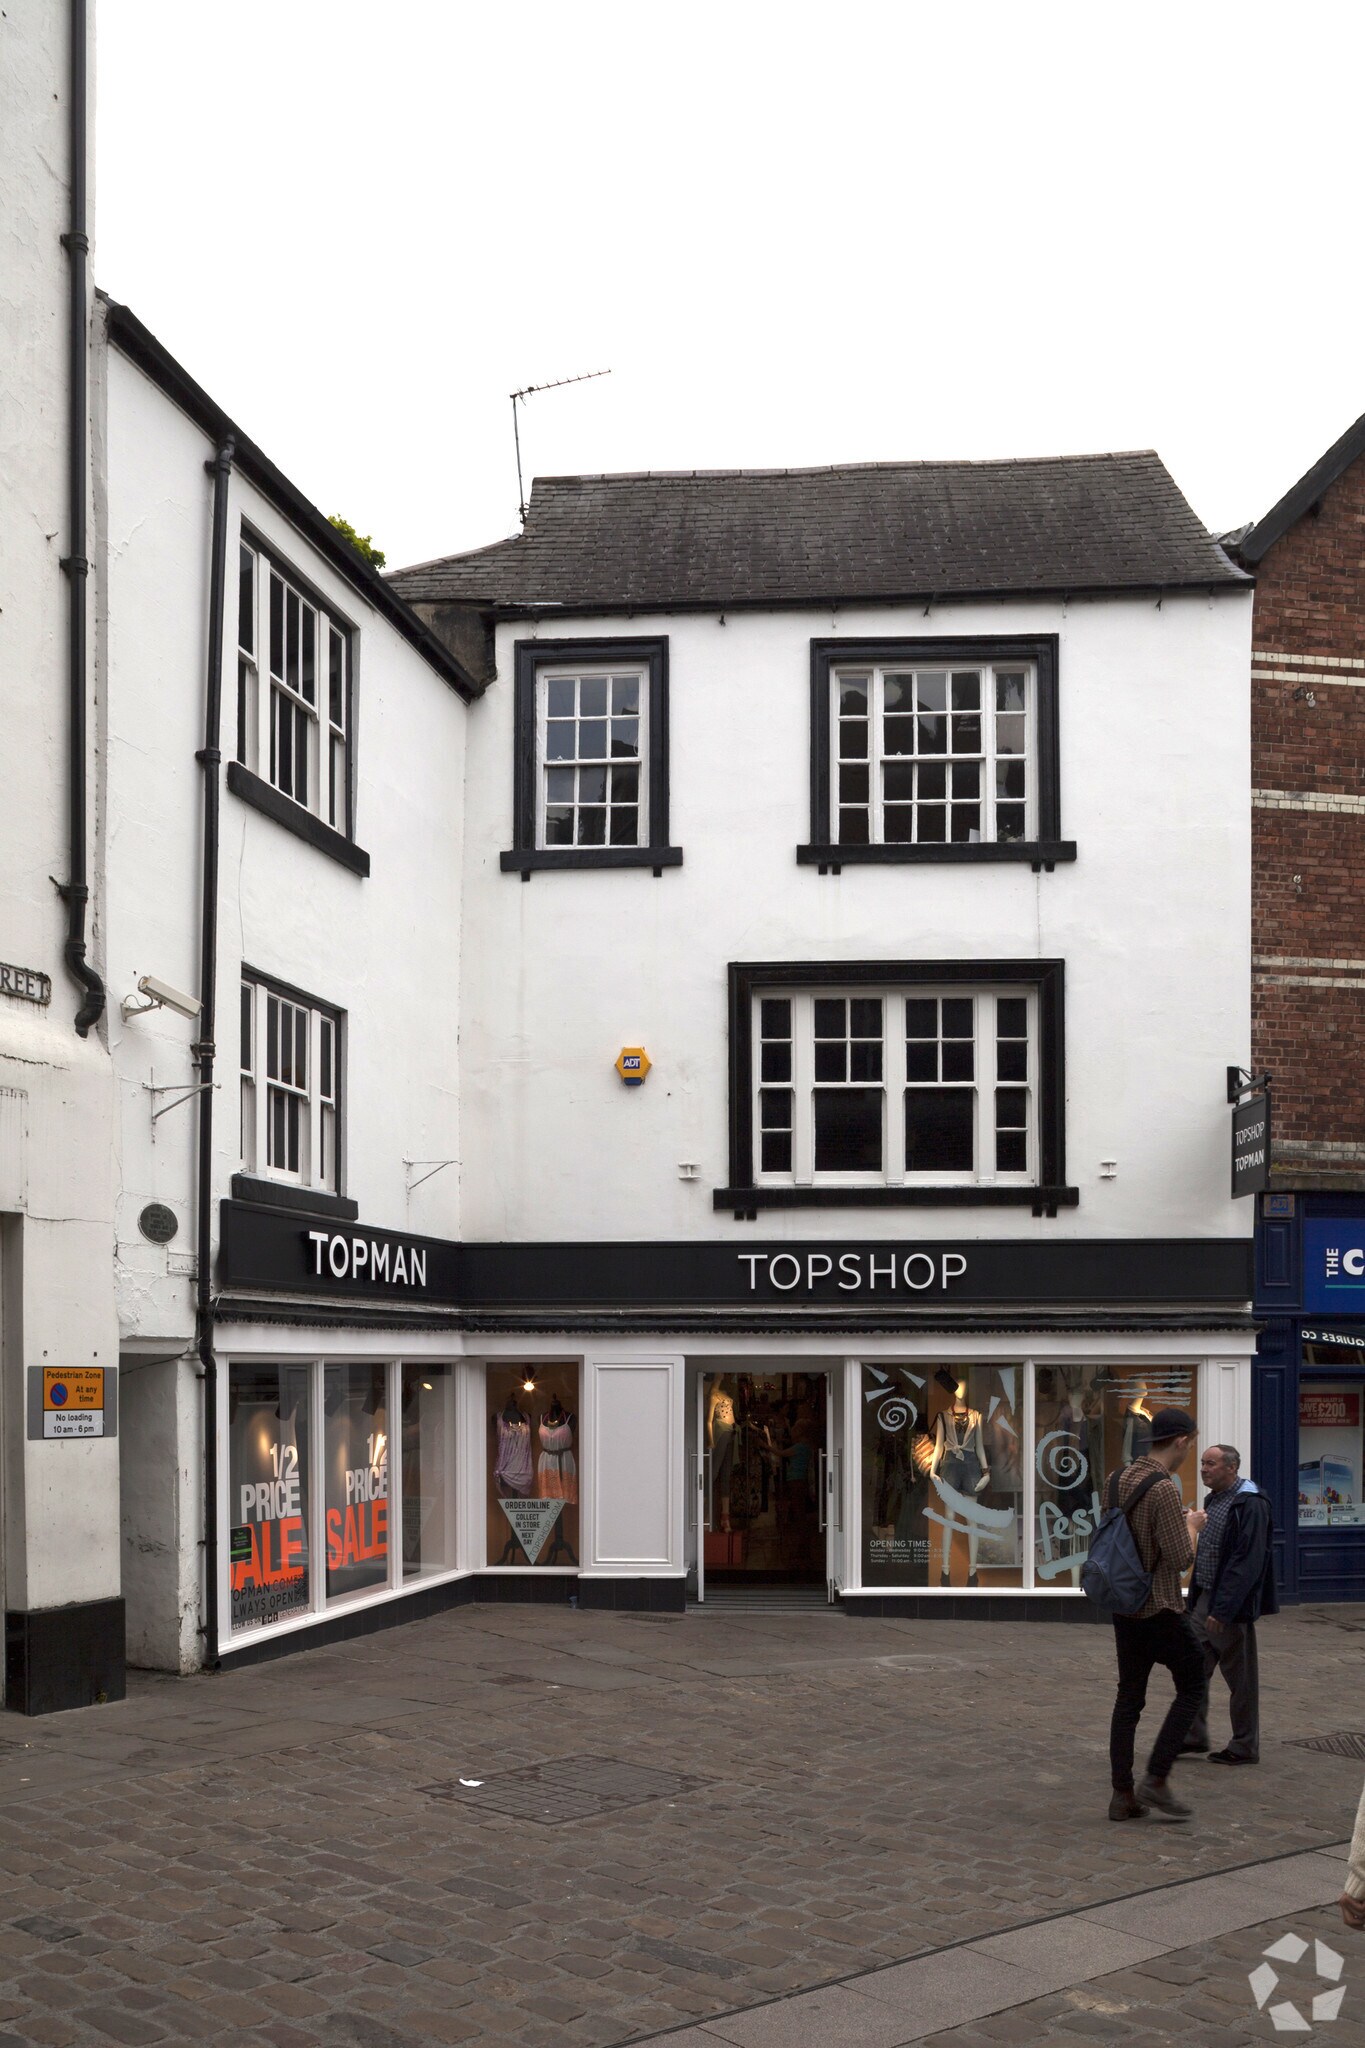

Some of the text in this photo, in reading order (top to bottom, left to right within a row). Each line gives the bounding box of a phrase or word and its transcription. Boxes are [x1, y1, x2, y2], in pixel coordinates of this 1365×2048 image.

[623, 1058, 640, 1068] ADT
[1235, 1121, 1265, 1146] TOPSHOP
[1235, 1149, 1265, 1172] TOPMAN
[309, 1231, 427, 1287] TOPMAN
[737, 1253, 968, 1290] TOPSHOP
[1326, 1248, 1339, 1278] THE
[46, 1371, 101, 1379] Pedestrian Zone
[68, 1413, 93, 1422] loading
[1299, 1402, 1346, 1417] SAVE £200
[78, 1425, 83, 1433] 6
[84, 1426, 94, 1434] pm
[269, 1443, 299, 1480] 1/2
[345, 1465, 388, 1505] PRICE
[240, 1478, 302, 1524] PRICE
[505, 1501, 550, 1509] ORDER ONLINE
[326, 1498, 388, 1571] SALE
[529, 1501, 563, 1557] TOPSHOP.COM
[230, 1516, 303, 1592] ALE
[270, 1591, 293, 1608] OPEN
